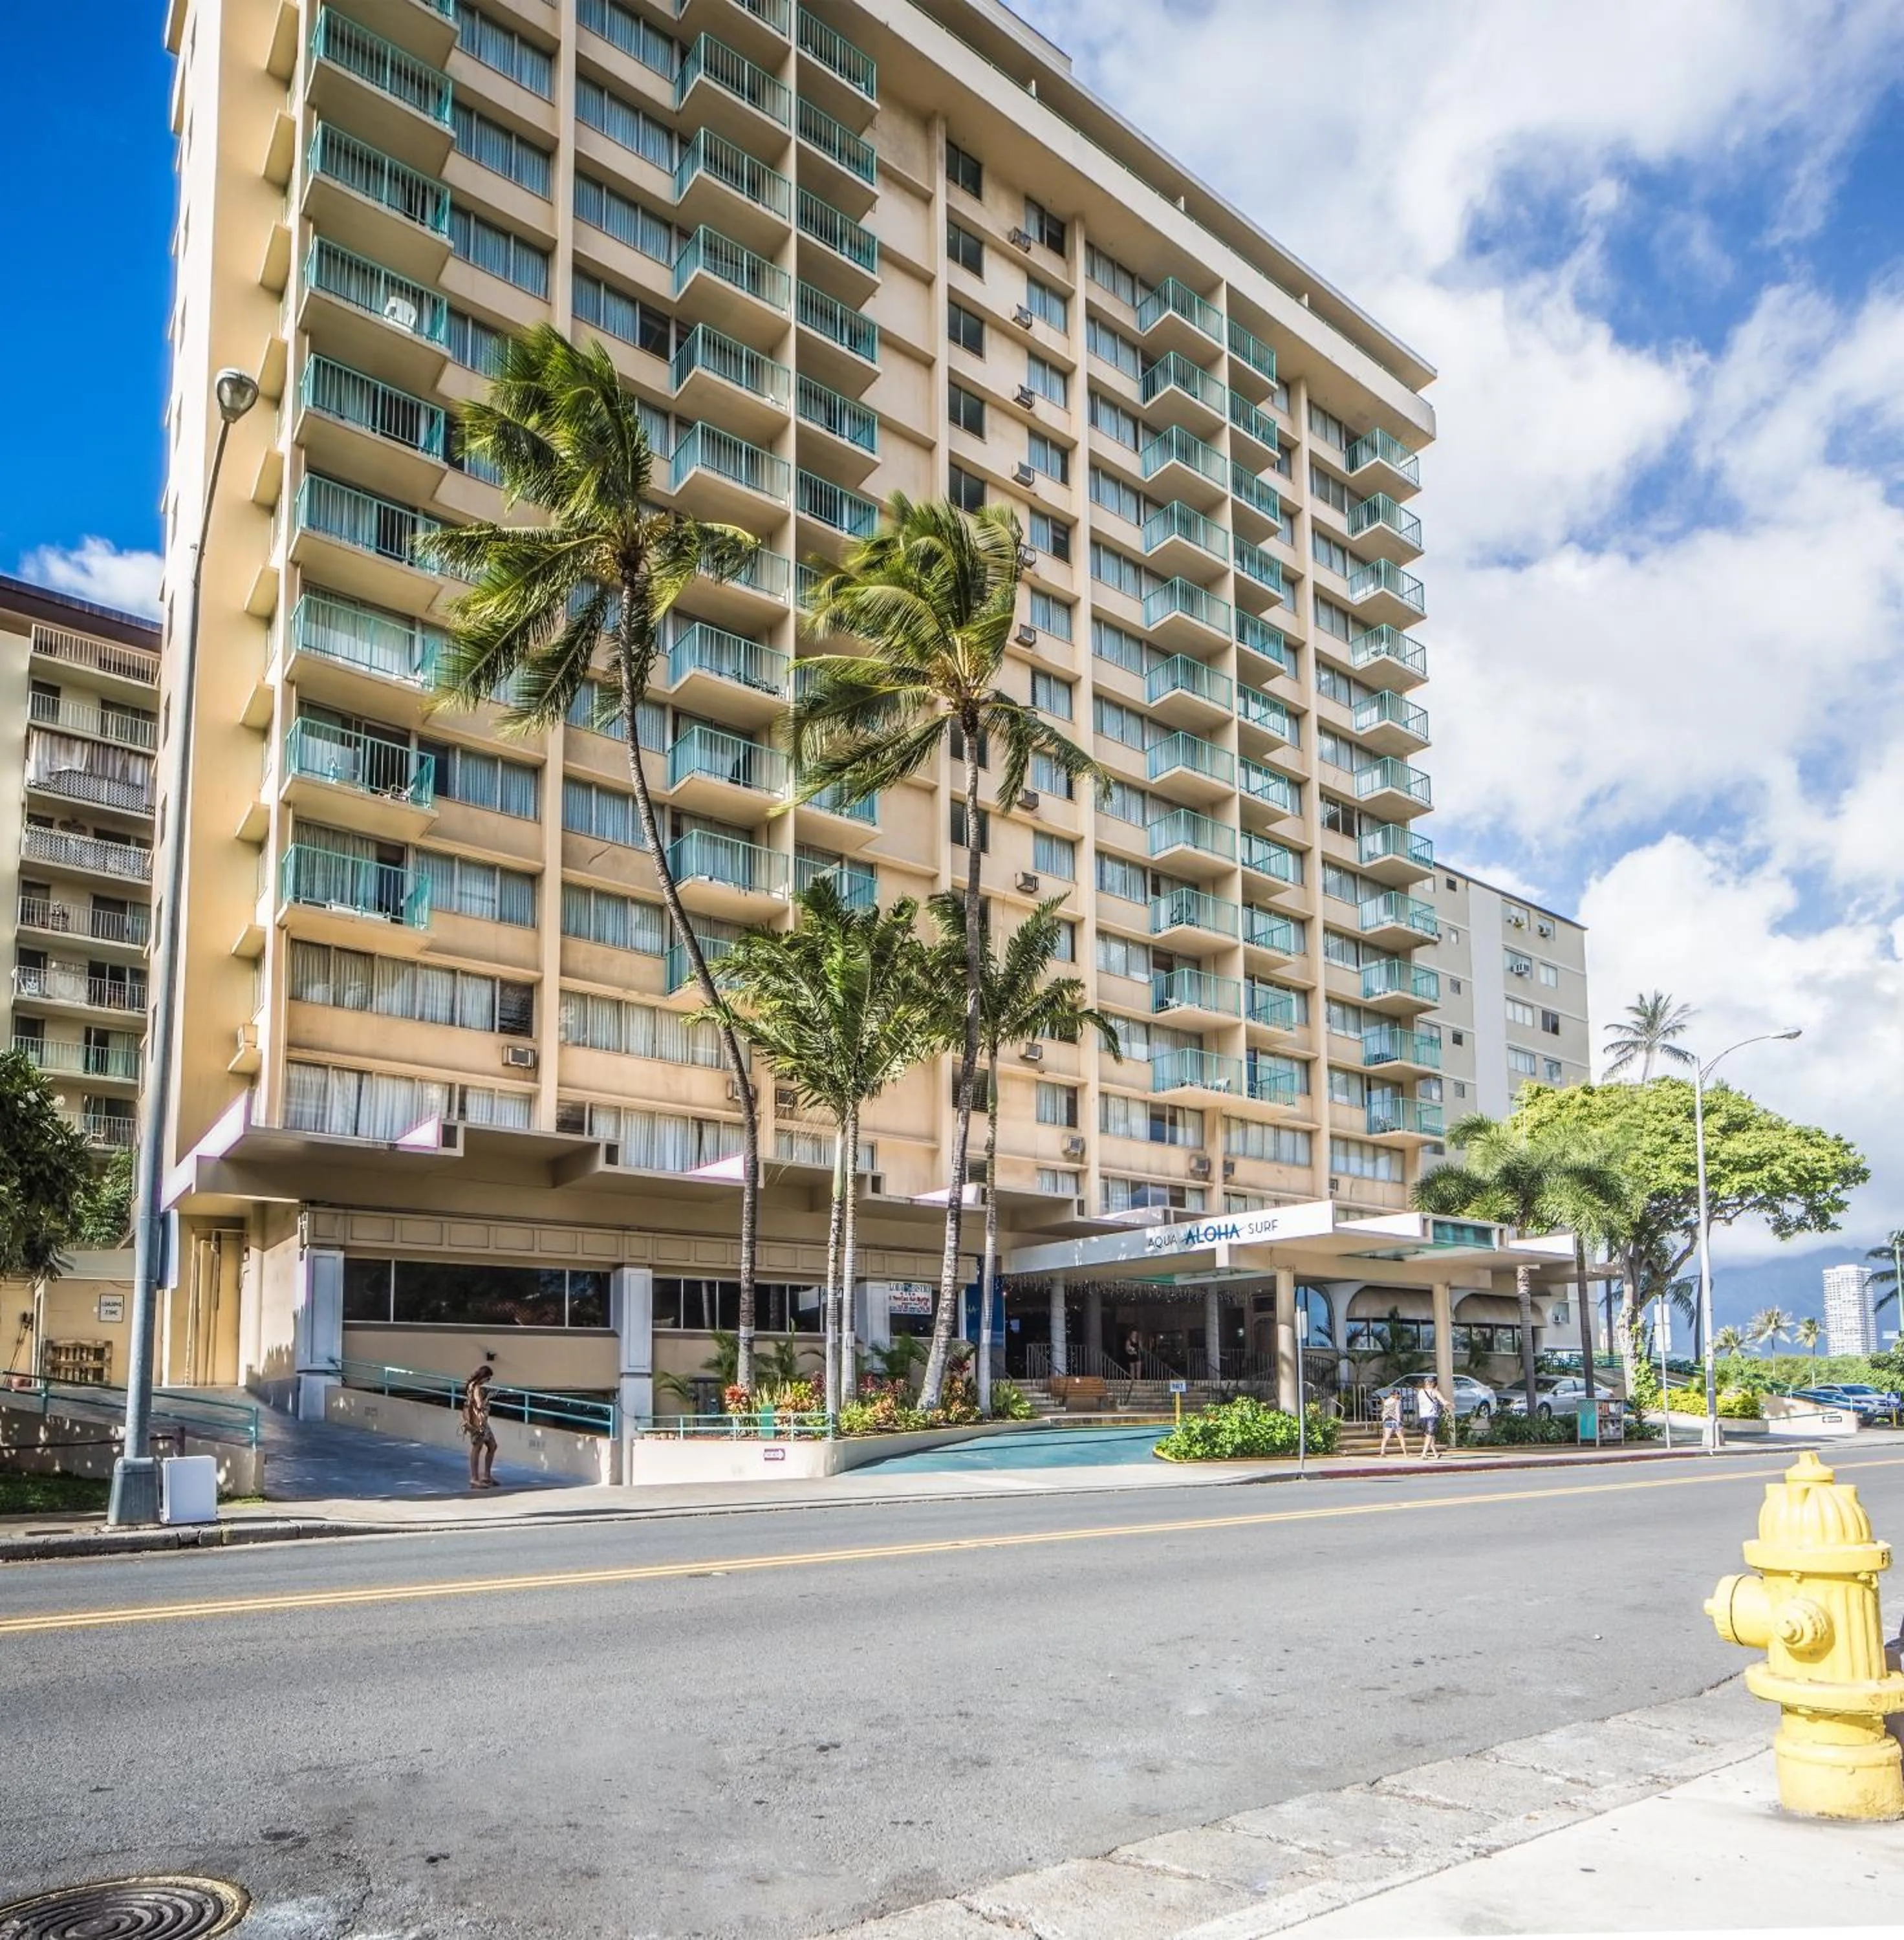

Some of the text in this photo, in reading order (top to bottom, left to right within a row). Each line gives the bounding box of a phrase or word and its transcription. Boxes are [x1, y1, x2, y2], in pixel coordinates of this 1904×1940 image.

[1148, 1219, 1279, 1248] AQUA ALOHA SURF
